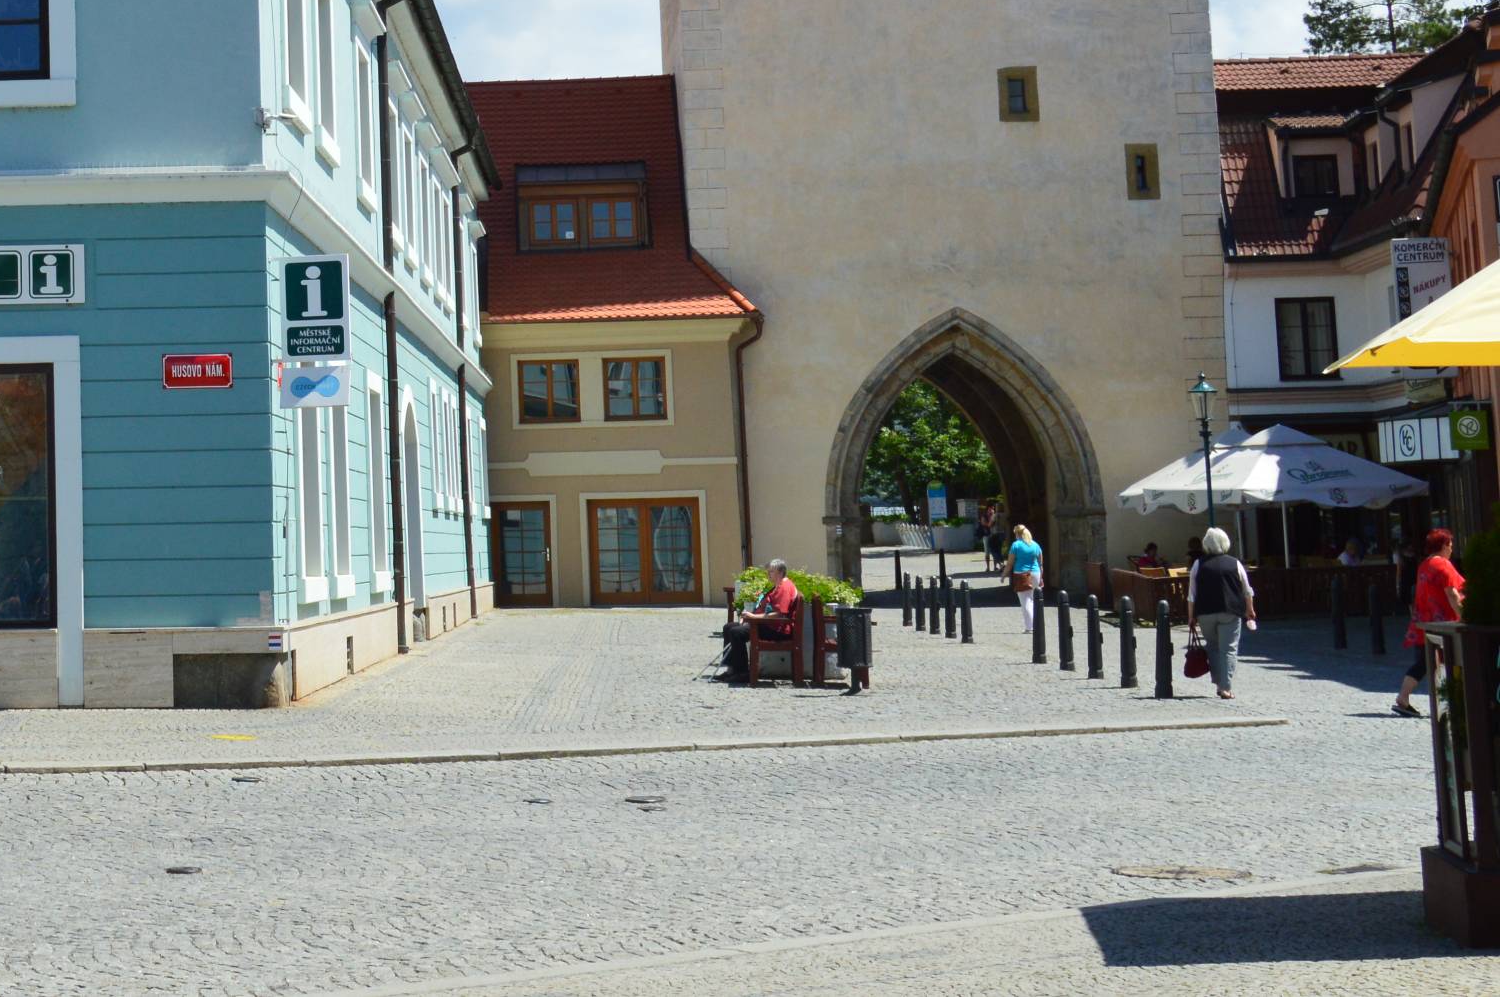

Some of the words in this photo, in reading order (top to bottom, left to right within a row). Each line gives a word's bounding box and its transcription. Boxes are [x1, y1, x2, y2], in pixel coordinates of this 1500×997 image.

[1394, 240, 1446, 252] KOMERČNÍ
[1397, 252, 1445, 261] CENTRUM
[1413, 274, 1446, 294] NÁKUPY
[299, 328, 332, 337] MĚSTSKÉ
[290, 335, 341, 345] INFORMAČNÍ
[296, 345, 334, 354] CENTRUM
[171, 365, 202, 378] HUSOVO
[205, 362, 225, 377] NÁM.
